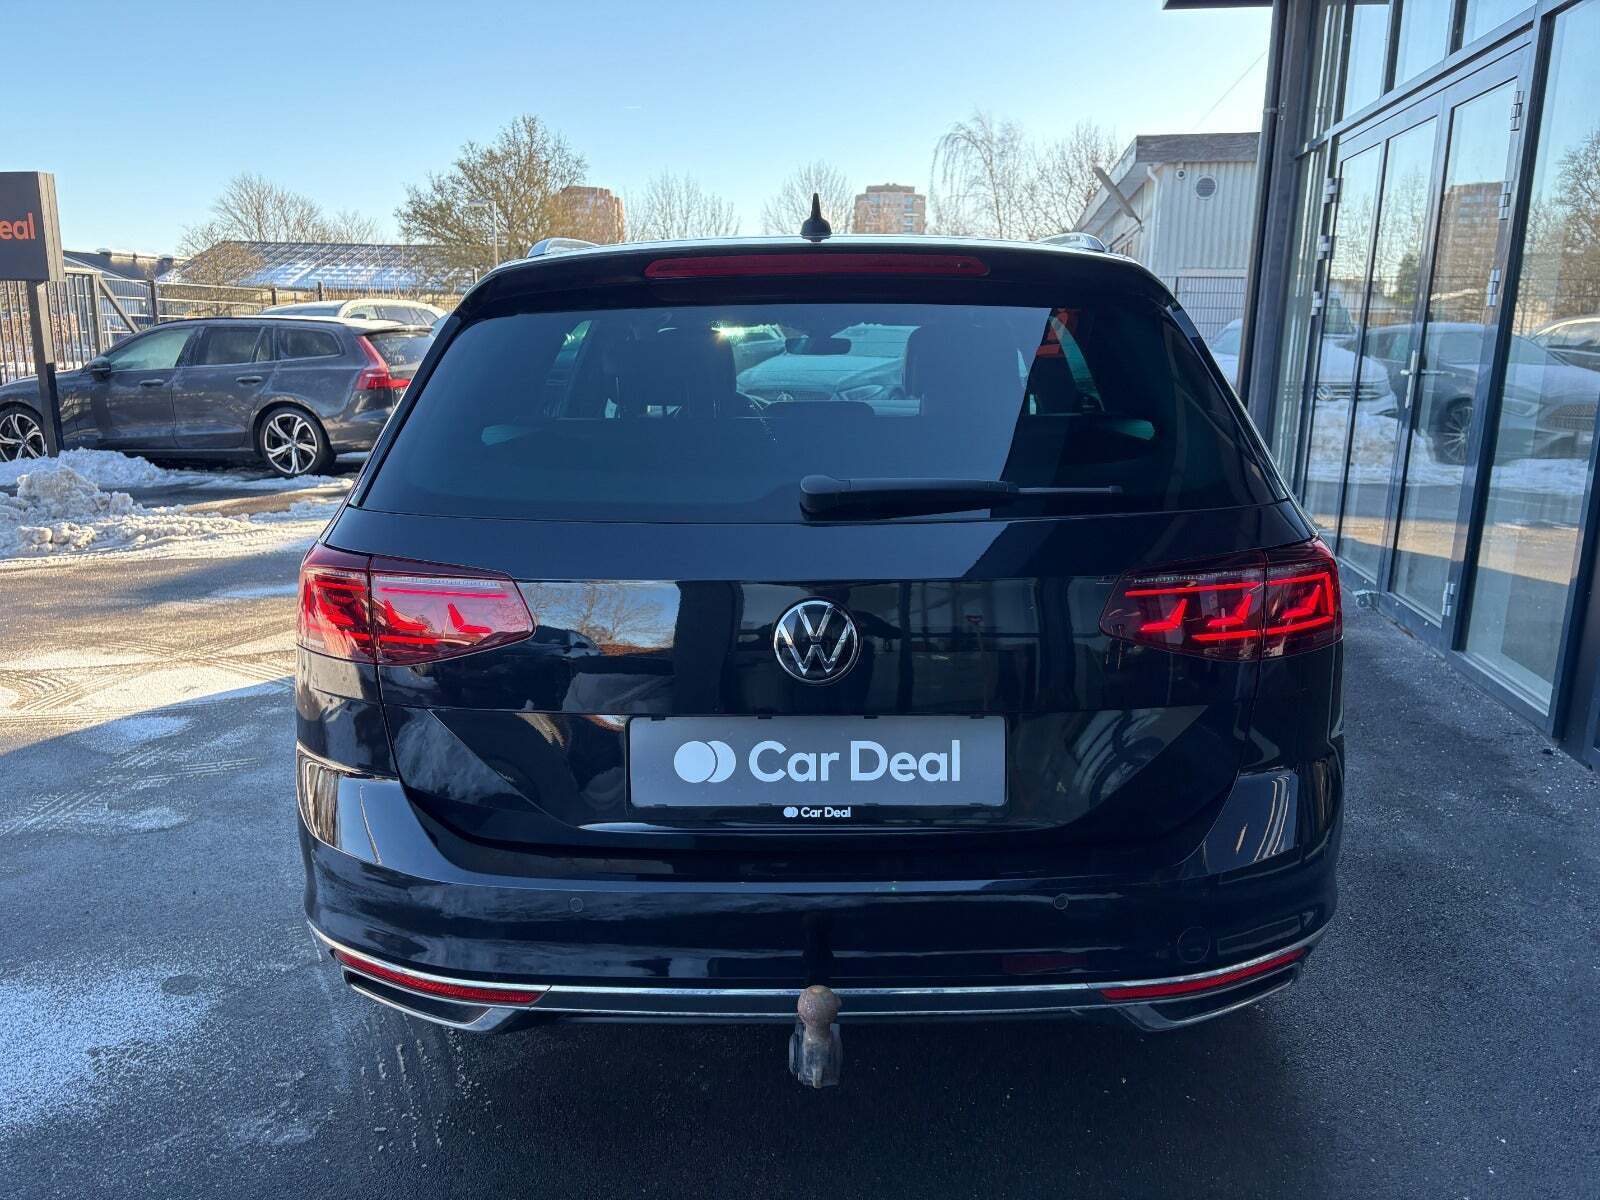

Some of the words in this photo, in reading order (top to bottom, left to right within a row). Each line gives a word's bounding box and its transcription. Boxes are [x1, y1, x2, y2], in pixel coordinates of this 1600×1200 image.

[776, 601, 855, 680] VW
[748, 740, 840, 783] Car
[850, 739, 961, 783] Deal
[800, 806, 823, 818] Car
[824, 806, 852, 818] Deal
